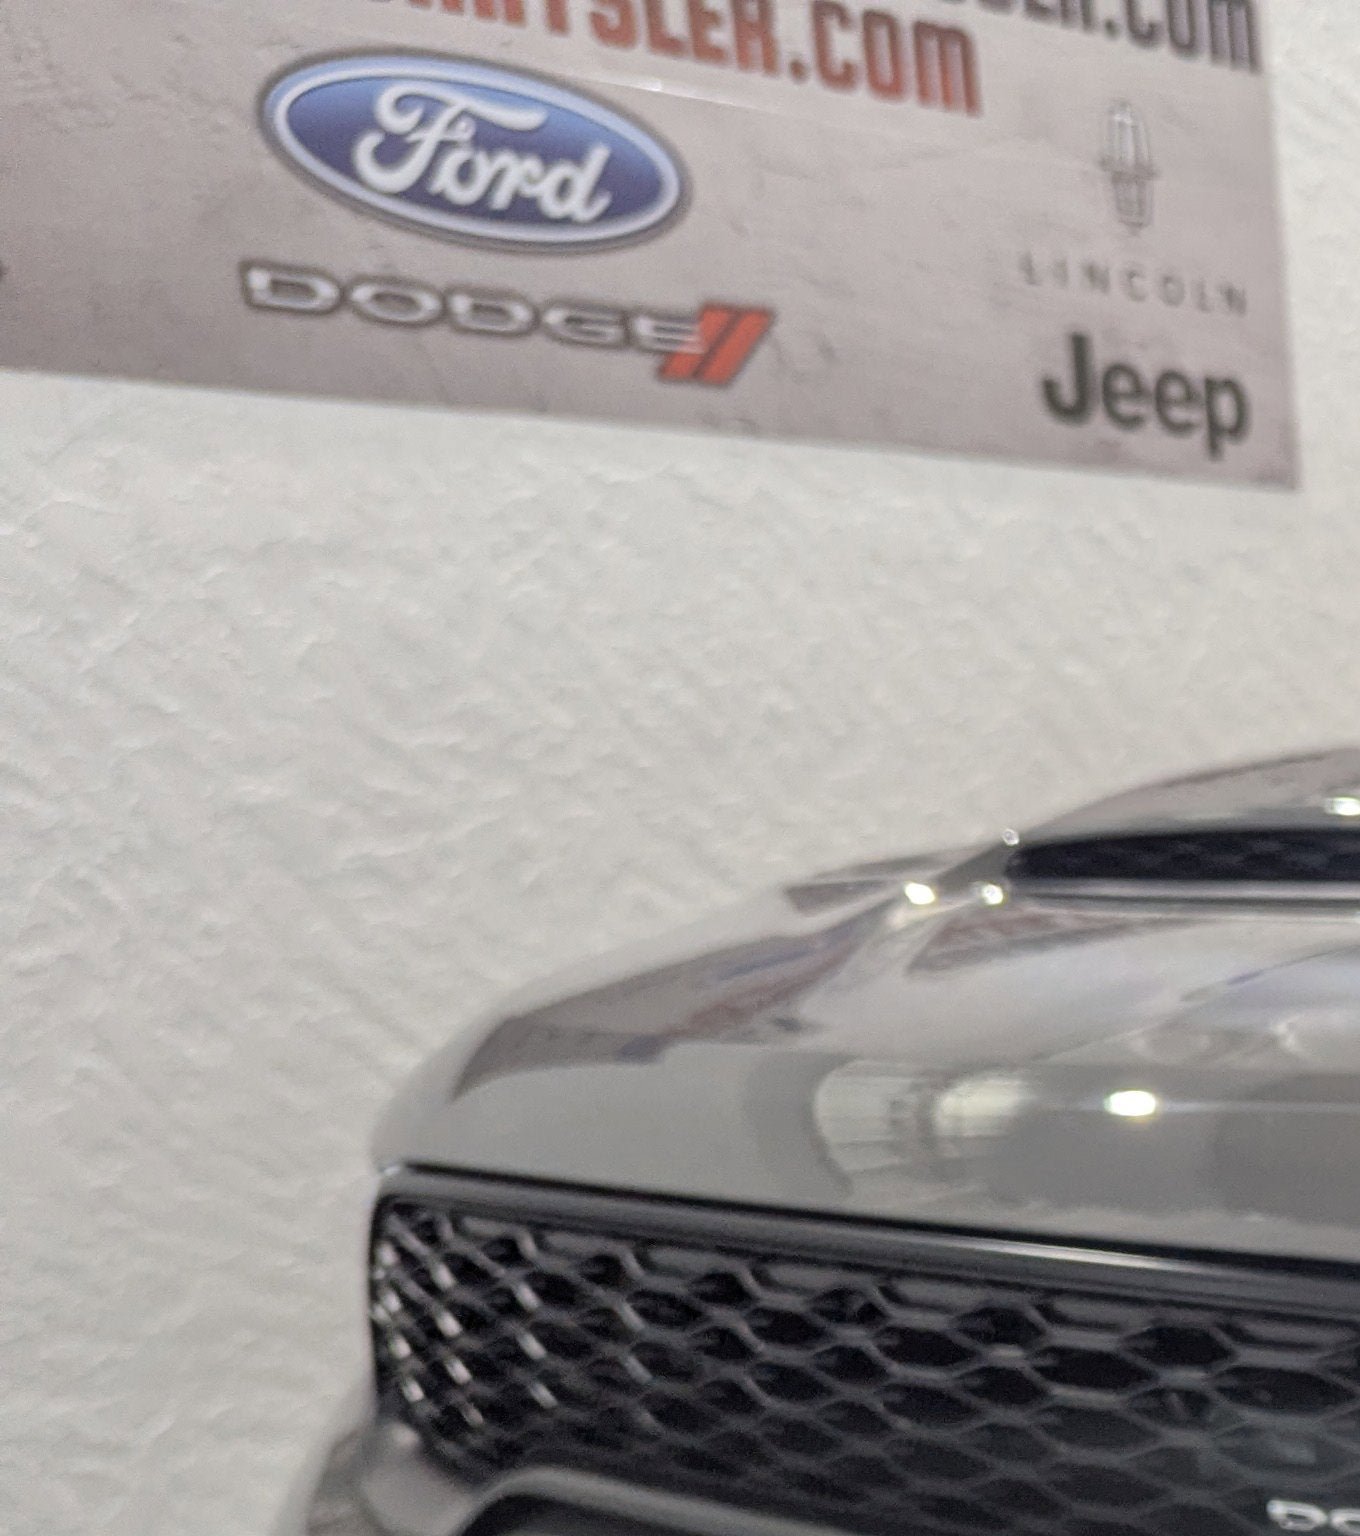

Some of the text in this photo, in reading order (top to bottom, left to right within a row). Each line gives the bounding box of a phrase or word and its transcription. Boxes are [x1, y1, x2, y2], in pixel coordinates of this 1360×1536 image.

[352, 82, 610, 223] Ford
[240, 258, 706, 354] DODGE
[1018, 251, 1248, 317] LINCOLN
[1041, 333, 1252, 461] Jeep
